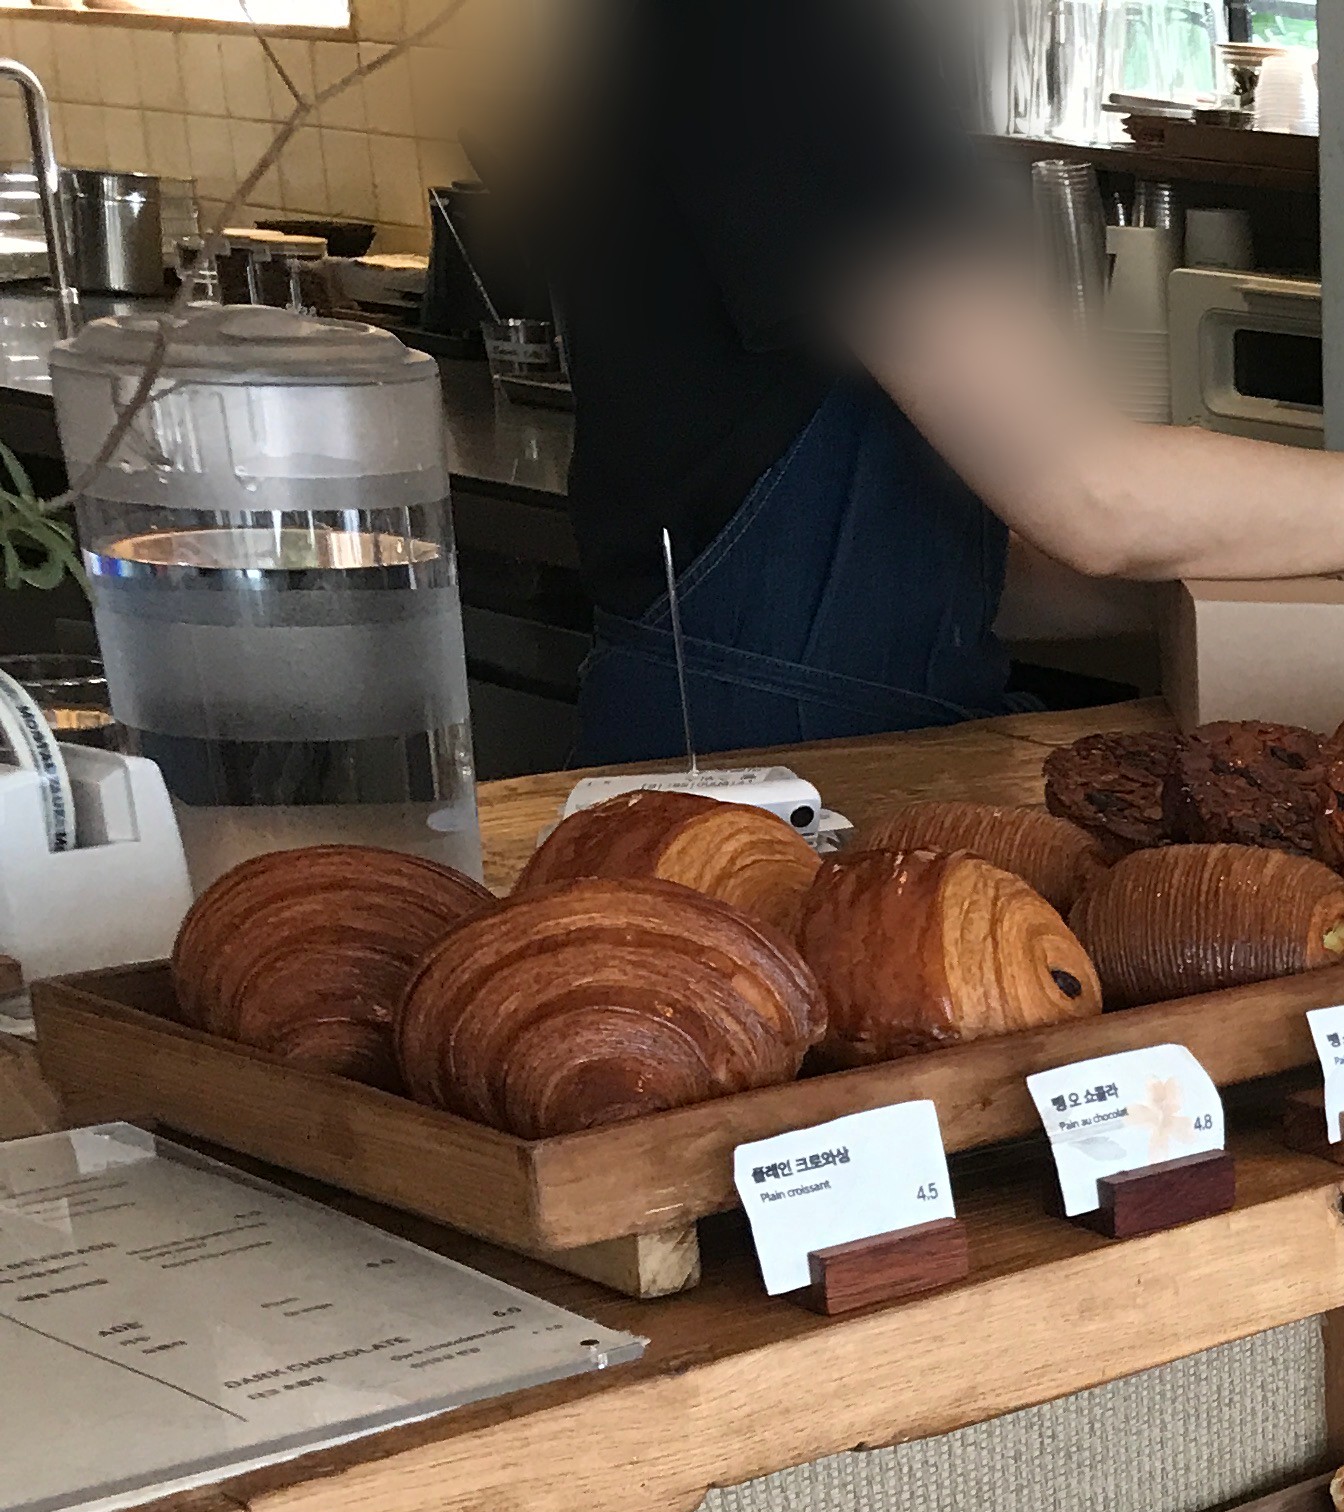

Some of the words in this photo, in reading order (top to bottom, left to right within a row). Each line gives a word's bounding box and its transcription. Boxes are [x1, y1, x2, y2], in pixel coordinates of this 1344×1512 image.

[1068, 1092, 1082, 1108] 오
[1083, 1082, 1119, 1105] 쇼콜라
[1059, 1121, 1080, 1131] Pain
[1081, 1118, 1092, 1126] au
[1092, 1107, 1129, 1123] chocolat
[1193, 1114, 1213, 1131] 4.8
[751, 1160, 793, 1183] 플레인
[795, 1146, 851, 1172] 크로와상
[760, 1189, 786, 1203] Plain
[787, 1179, 832, 1198] croissant
[916, 1181, 939, 1201] 4.5
[224, 1368, 287, 1390] DARK
[286, 1336, 411, 1372] CHOCOLATE
